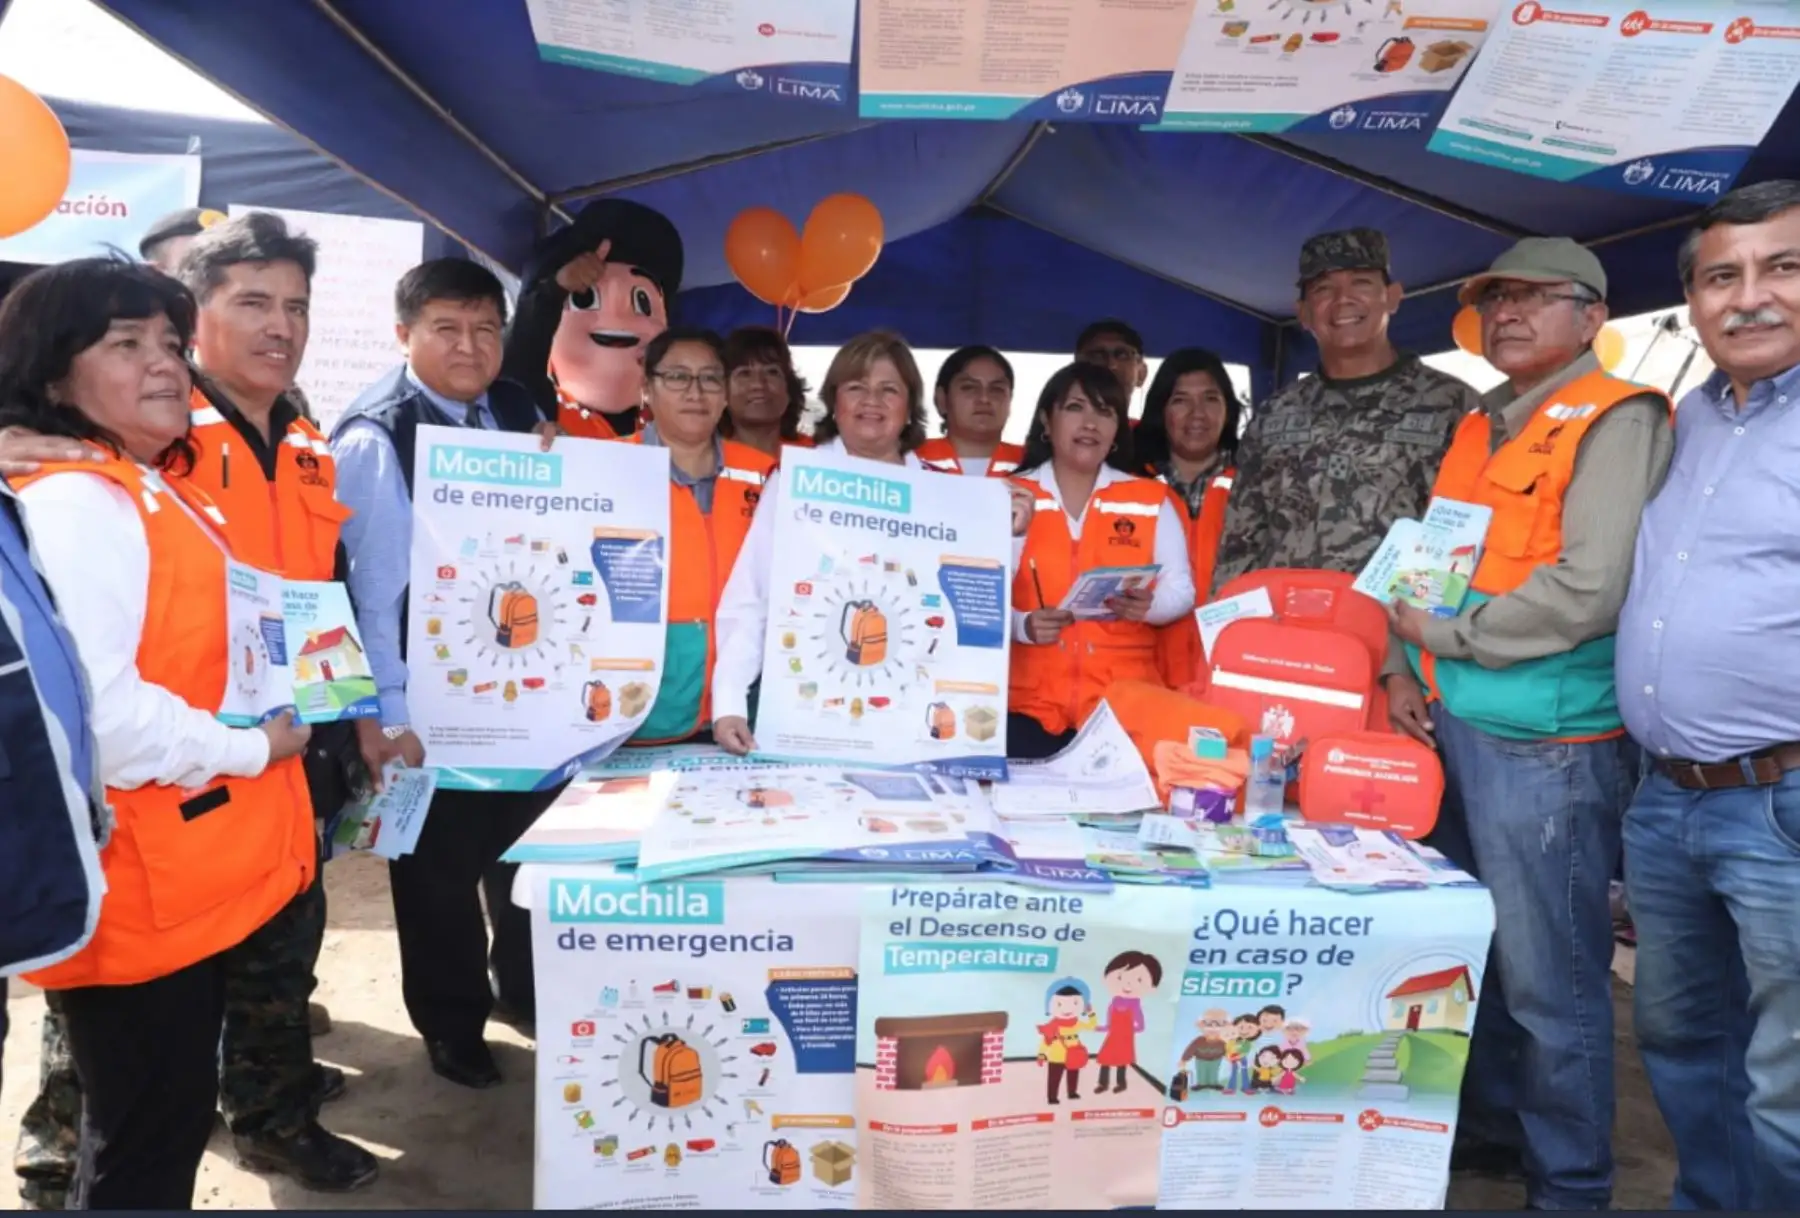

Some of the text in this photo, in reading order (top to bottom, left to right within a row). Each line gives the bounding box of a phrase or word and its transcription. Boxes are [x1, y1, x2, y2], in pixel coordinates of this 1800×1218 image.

[778, 83, 841, 101] LIMA
[1096, 100, 1157, 115] LIMA
[1363, 116, 1421, 129] LIMA
[1659, 174, 1720, 194] LIMA
[56, 194, 128, 217] ación
[435, 448, 552, 482] Mochila
[433, 485, 614, 516] de emergencia
[797, 470, 902, 507] Mochila
[794, 503, 957, 542] de emergencia
[1033, 866, 1104, 880] LIMA
[556, 884, 709, 916] Mochila
[892, 887, 1083, 914] Prepárate ante
[889, 917, 1086, 942] el Descenso de
[1194, 908, 1374, 940] ¿Qué hacer
[557, 928, 794, 958] de emergencia
[889, 945, 1050, 971] Temperatura
[1189, 945, 1354, 967] en caso de
[1182, 973, 1303, 996] sismo ?
